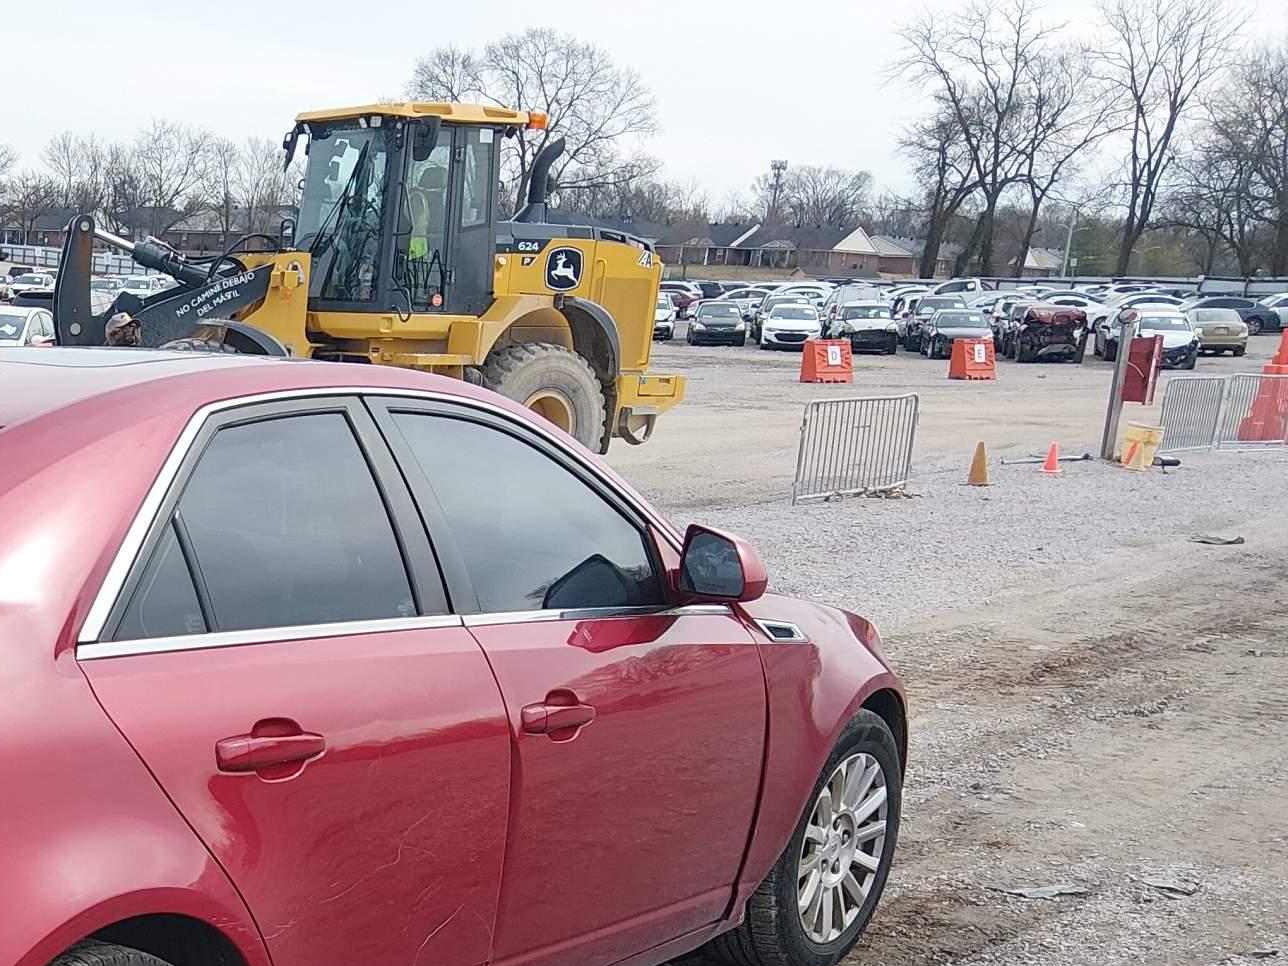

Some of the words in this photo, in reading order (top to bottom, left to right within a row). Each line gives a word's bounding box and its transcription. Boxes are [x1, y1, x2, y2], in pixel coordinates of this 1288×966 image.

[518, 241, 539, 251] 624
[175, 304, 191, 318] NO
[190, 283, 222, 307] CAMINE
[222, 272, 255, 290] DEBAJO
[196, 304, 214, 317] DEL
